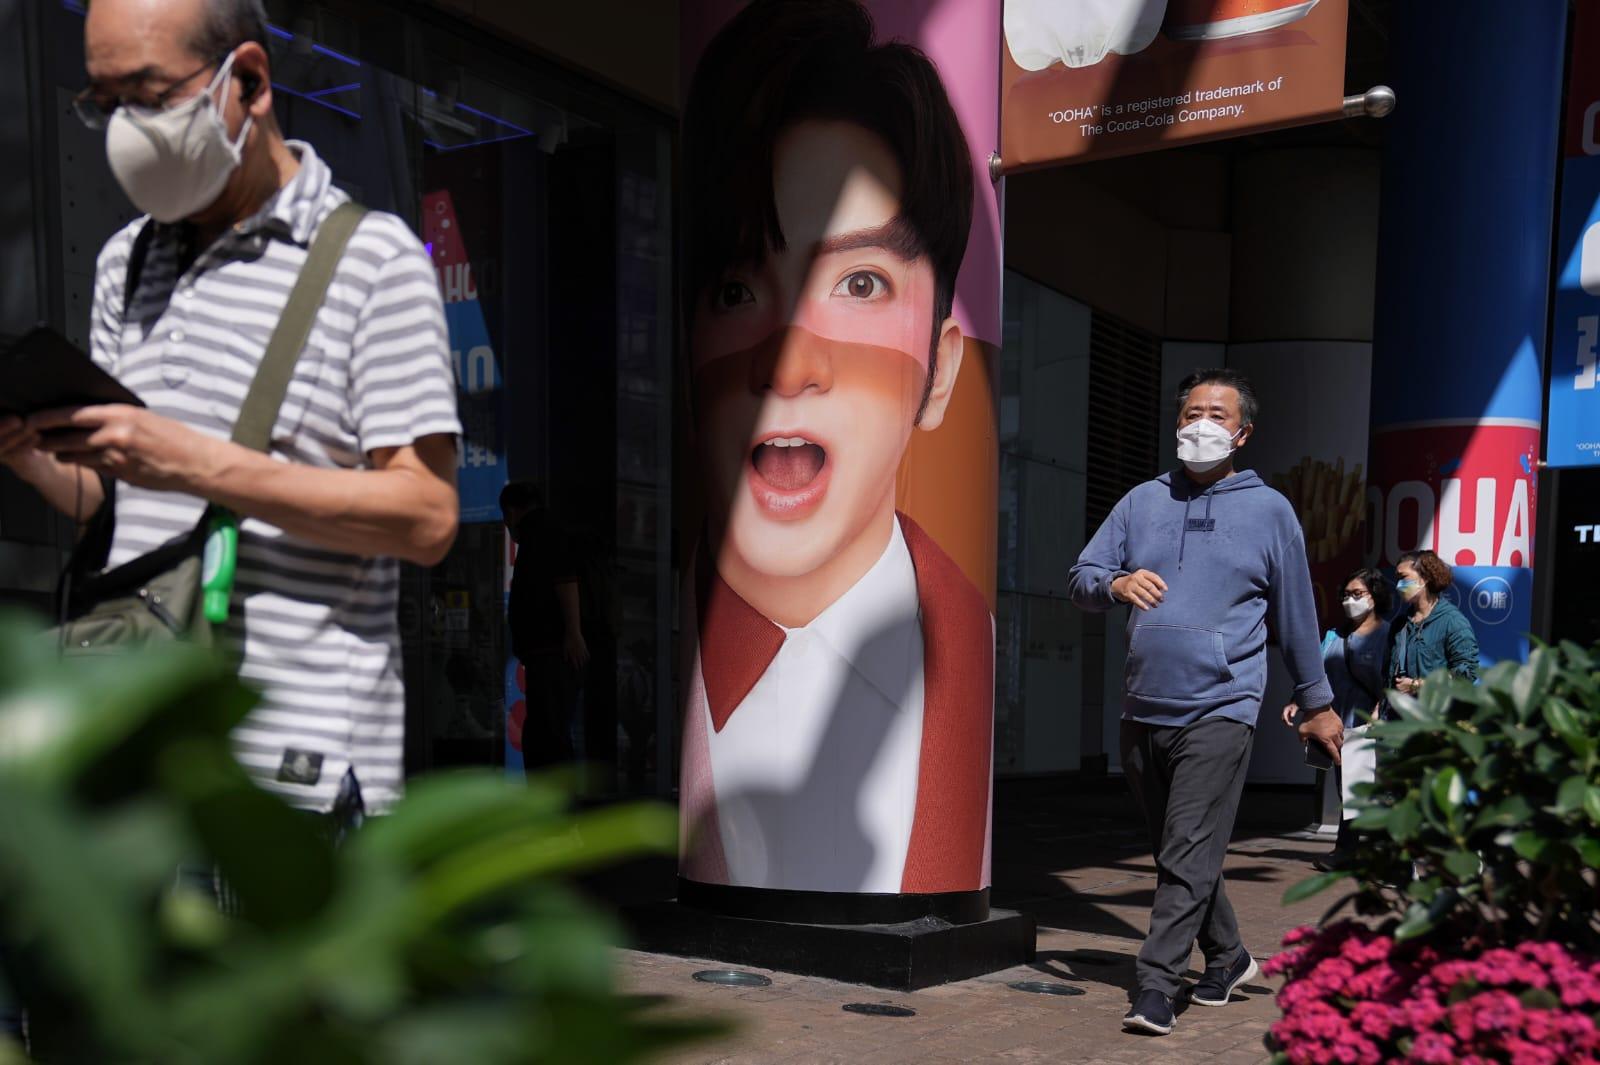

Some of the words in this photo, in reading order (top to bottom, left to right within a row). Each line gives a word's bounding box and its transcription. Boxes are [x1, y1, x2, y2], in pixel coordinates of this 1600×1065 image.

[1101, 105, 1112, 116] is
[1115, 104, 1123, 113] a
[1127, 91, 1191, 113] registered
[1195, 79, 1264, 102] trademark
[1268, 76, 1283, 91] of
[1080, 123, 1103, 137] The
[1107, 113, 1174, 133] Coca-Cola
[1178, 104, 1244, 122] Company.
